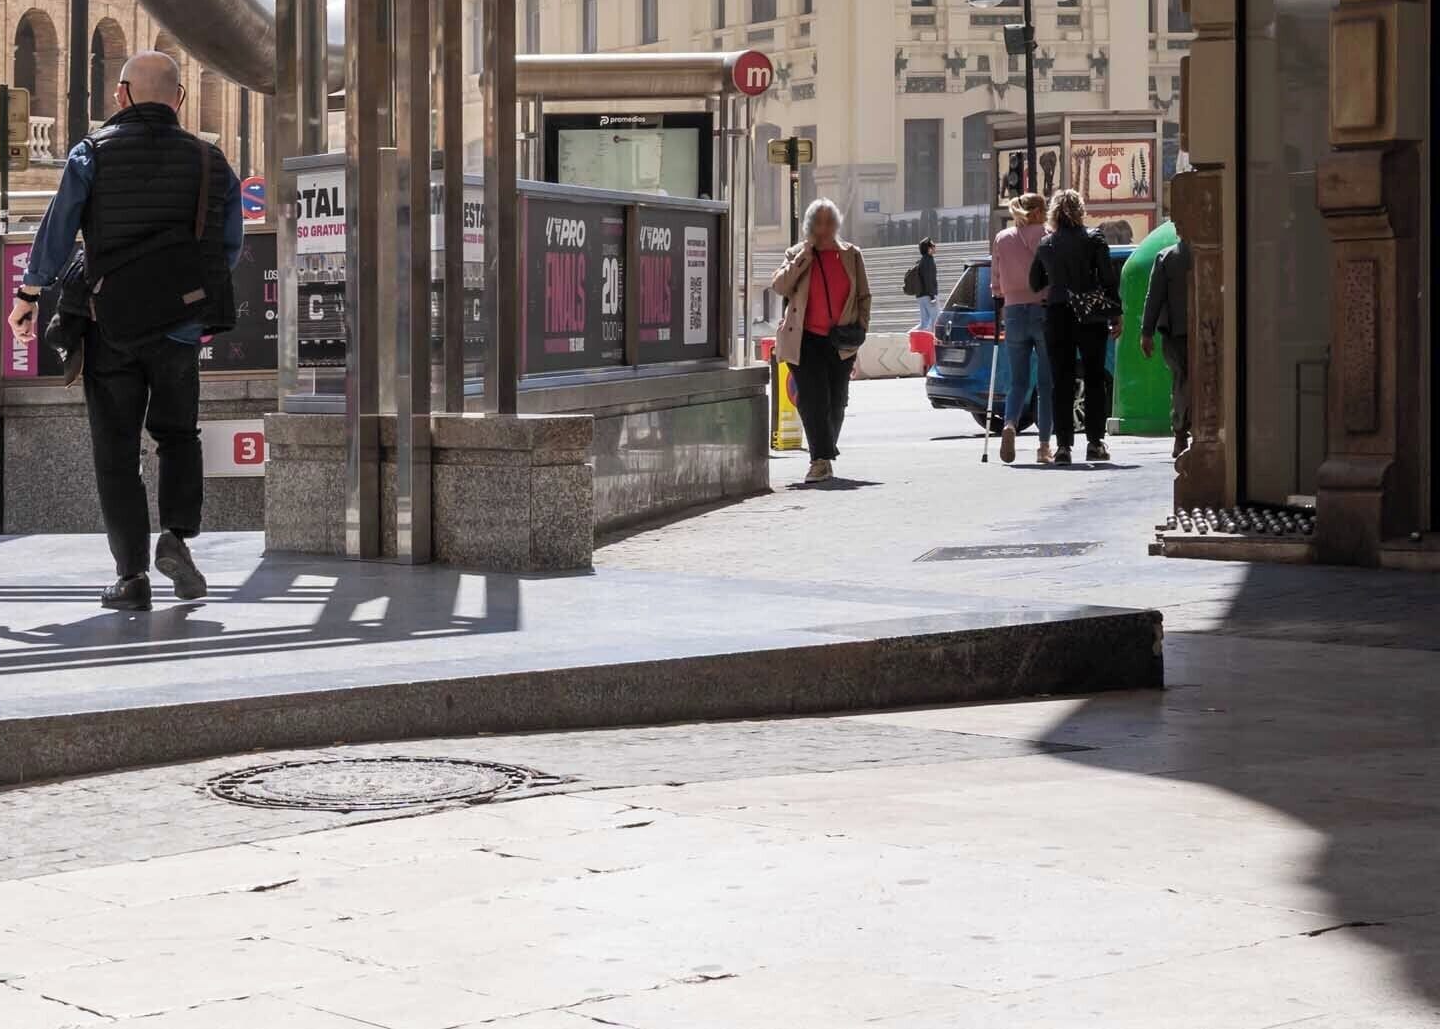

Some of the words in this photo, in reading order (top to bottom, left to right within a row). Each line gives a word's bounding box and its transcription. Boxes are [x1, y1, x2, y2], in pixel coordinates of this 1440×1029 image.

[747, 67, 771, 87] m
[545, 252, 586, 332] FINALS
[602, 258, 618, 314] 20
[241, 437, 256, 460] 3
